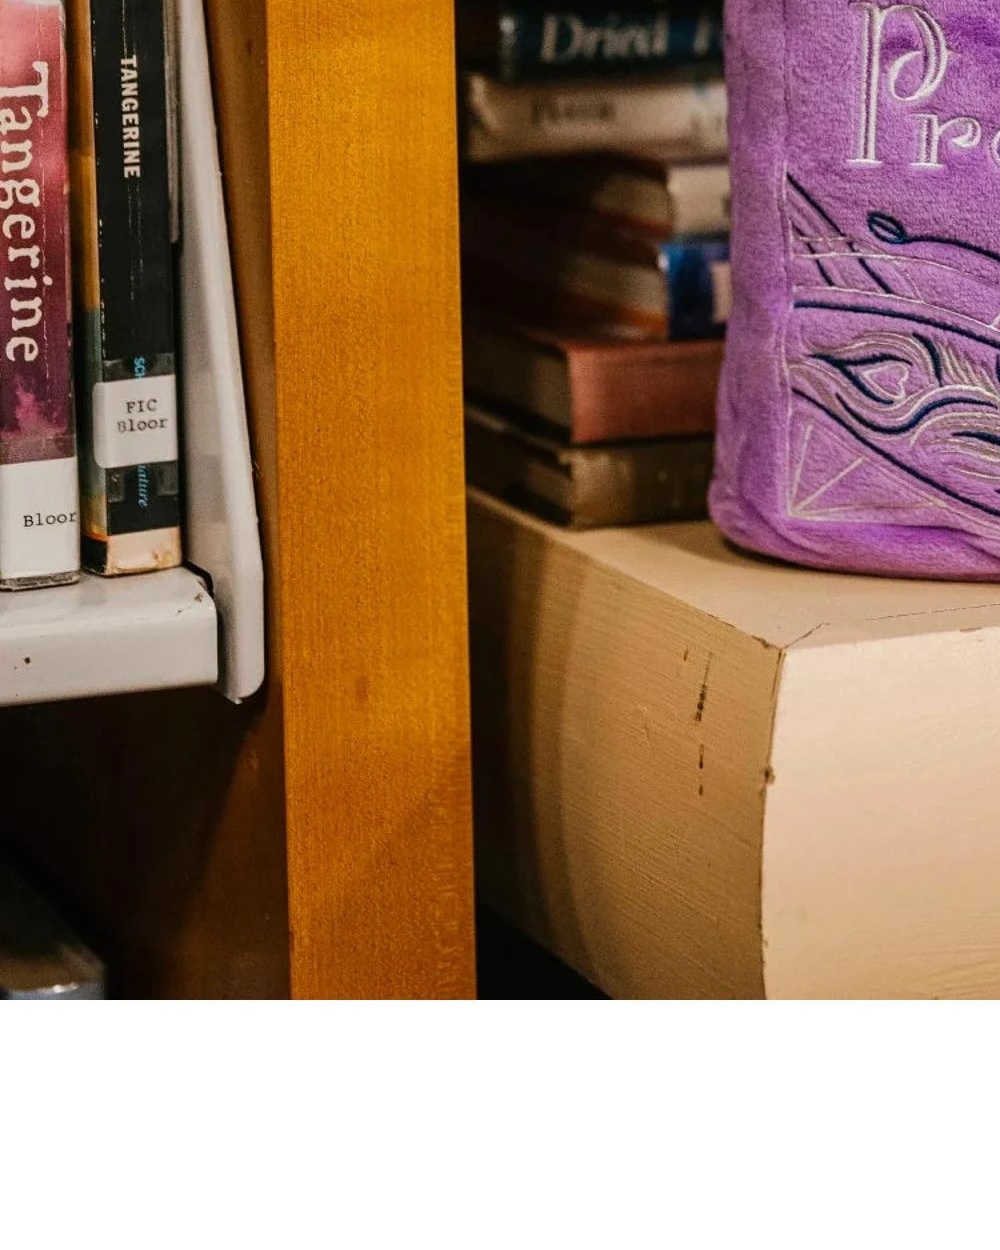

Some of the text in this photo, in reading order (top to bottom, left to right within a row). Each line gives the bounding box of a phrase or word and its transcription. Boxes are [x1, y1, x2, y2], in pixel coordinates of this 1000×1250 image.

[120, 53, 141, 179] TANGERINE
[0, 60, 53, 363] Tangerine
[125, 399, 158, 414] FIC
[117, 418, 168, 433] Bloor
[23, 511, 77, 528] Bloor
